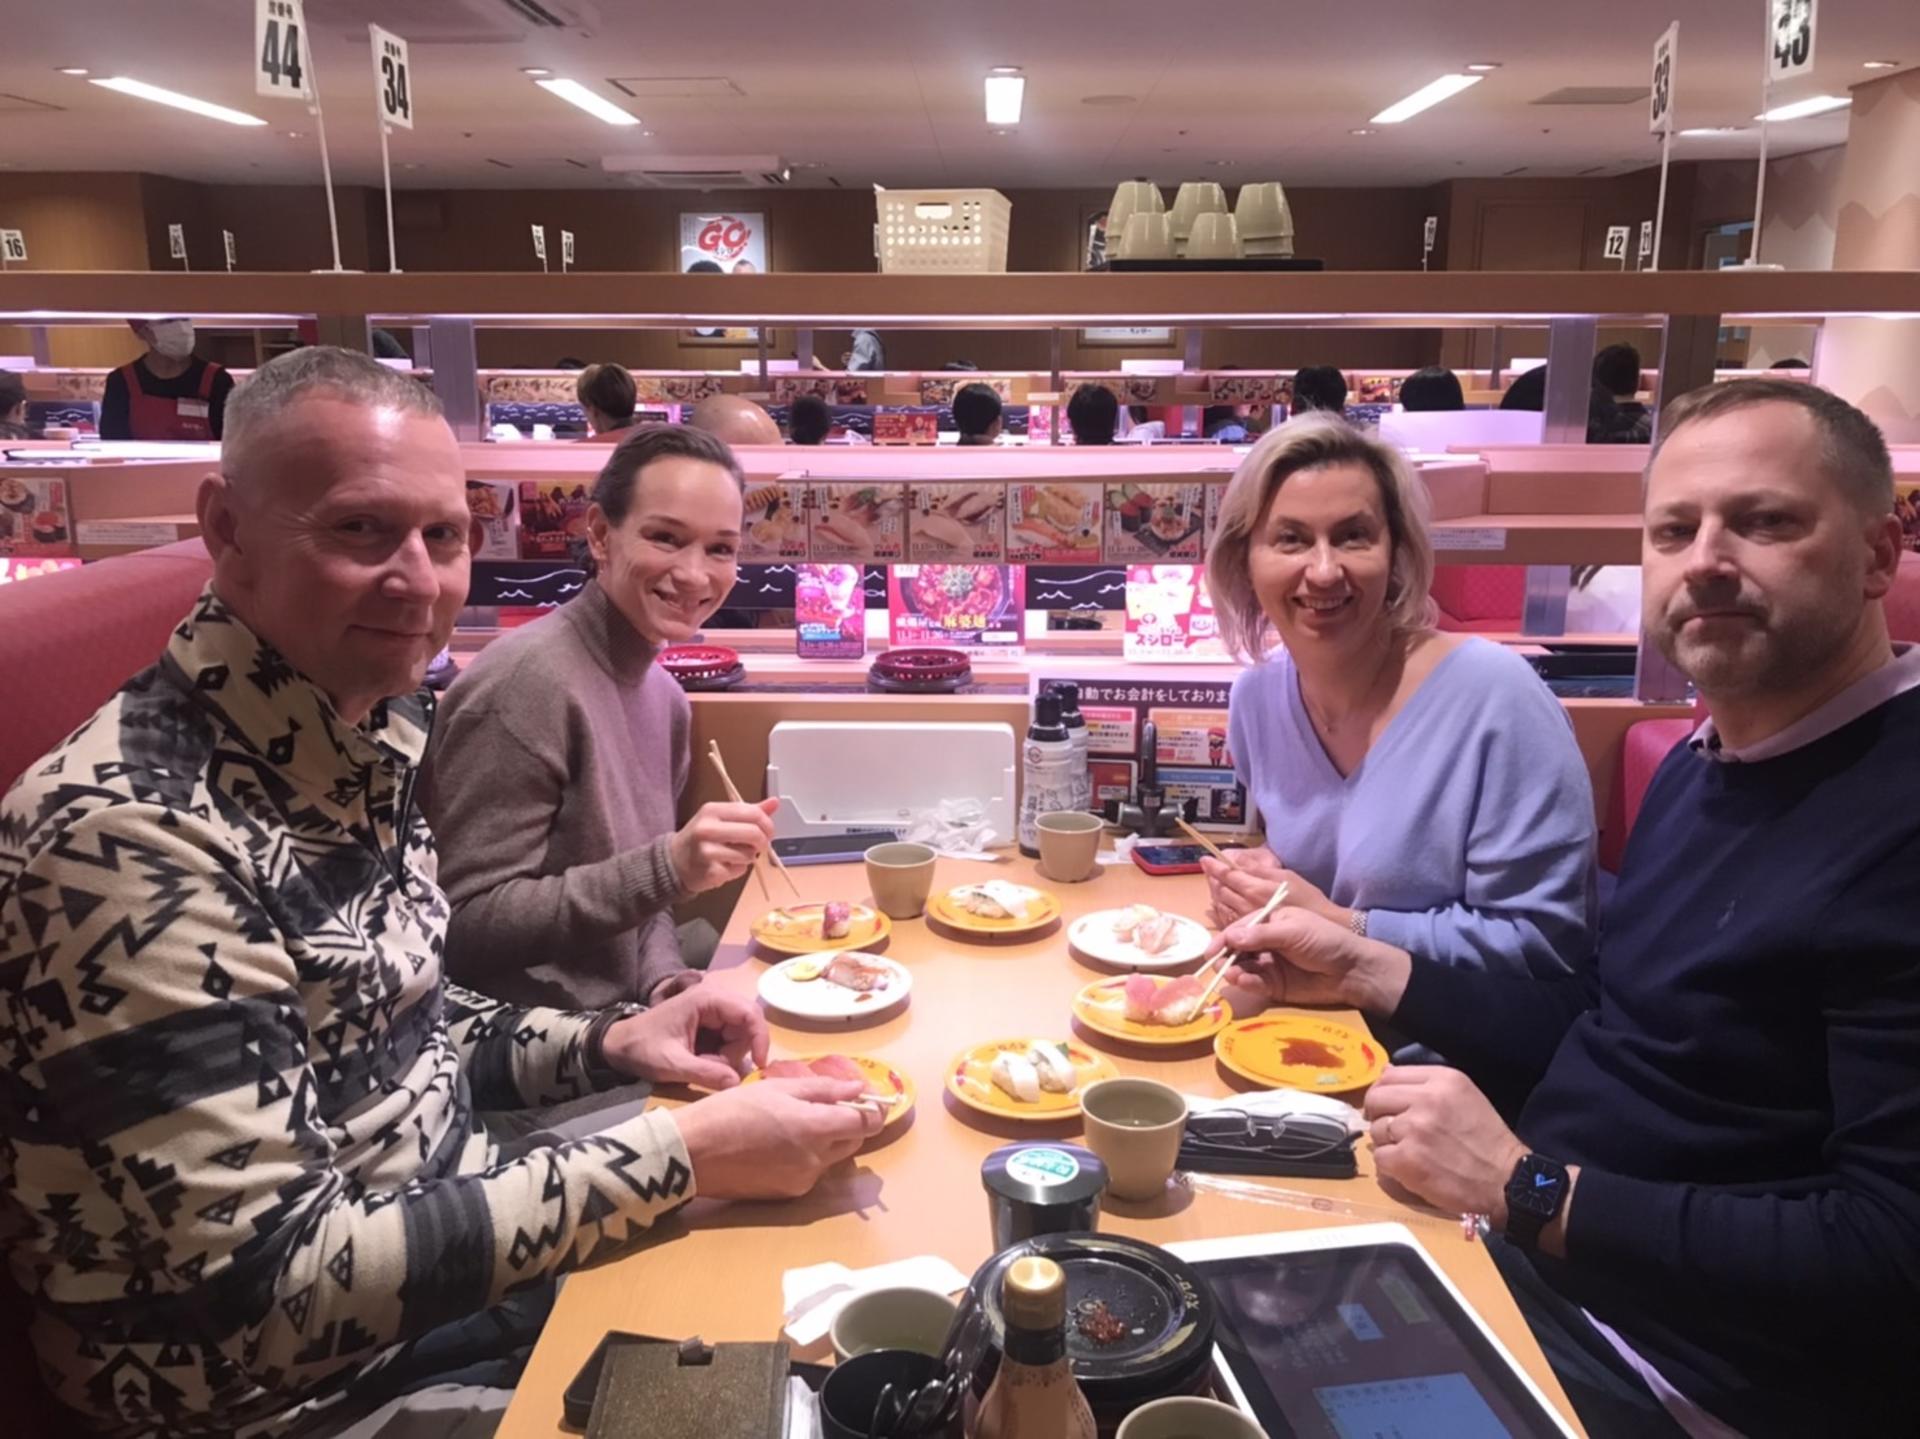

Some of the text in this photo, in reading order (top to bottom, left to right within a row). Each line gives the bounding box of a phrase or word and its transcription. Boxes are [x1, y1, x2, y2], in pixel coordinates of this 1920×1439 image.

[262, 19, 302, 89] 44
[381, 55, 409, 120] 34
[1652, 53, 1670, 121] 33
[5, 238, 24, 258] 16
[1608, 235, 1624, 255] 12
[1135, 633, 1184, 647] スシロー
[1077, 686, 1231, 703] 自動でお会計をしておりま
